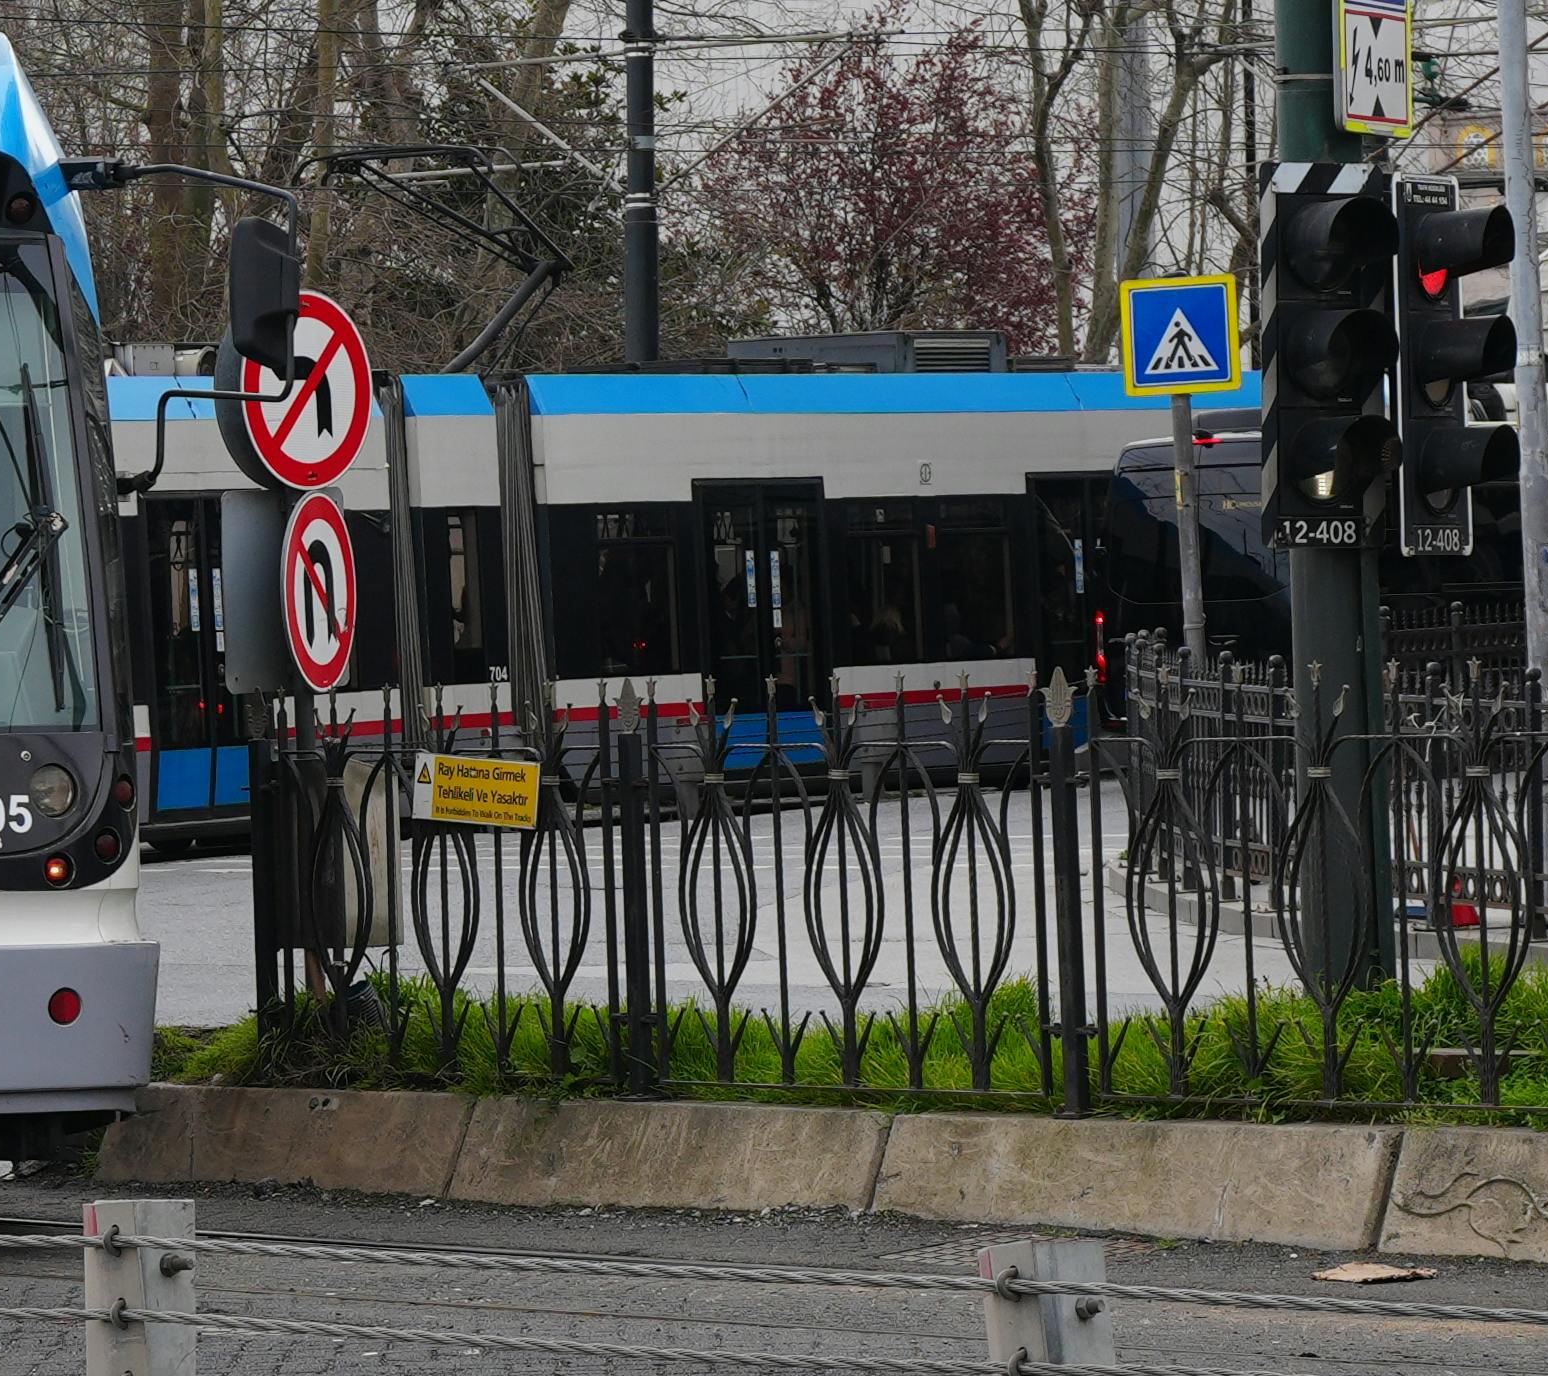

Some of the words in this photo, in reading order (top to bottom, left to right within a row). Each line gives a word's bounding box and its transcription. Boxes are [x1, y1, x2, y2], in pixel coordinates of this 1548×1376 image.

[1365, 46, 1390, 87] 4,60
[1394, 59, 1404, 83] m
[489, 666, 508, 681] 704
[438, 762, 455, 780] Ray
[493, 768, 526, 783] Girmek
[437, 785, 474, 802] Tehlikeli
[476, 789, 488, 803] Ve
[491, 791, 529, 806] Yasaktır
